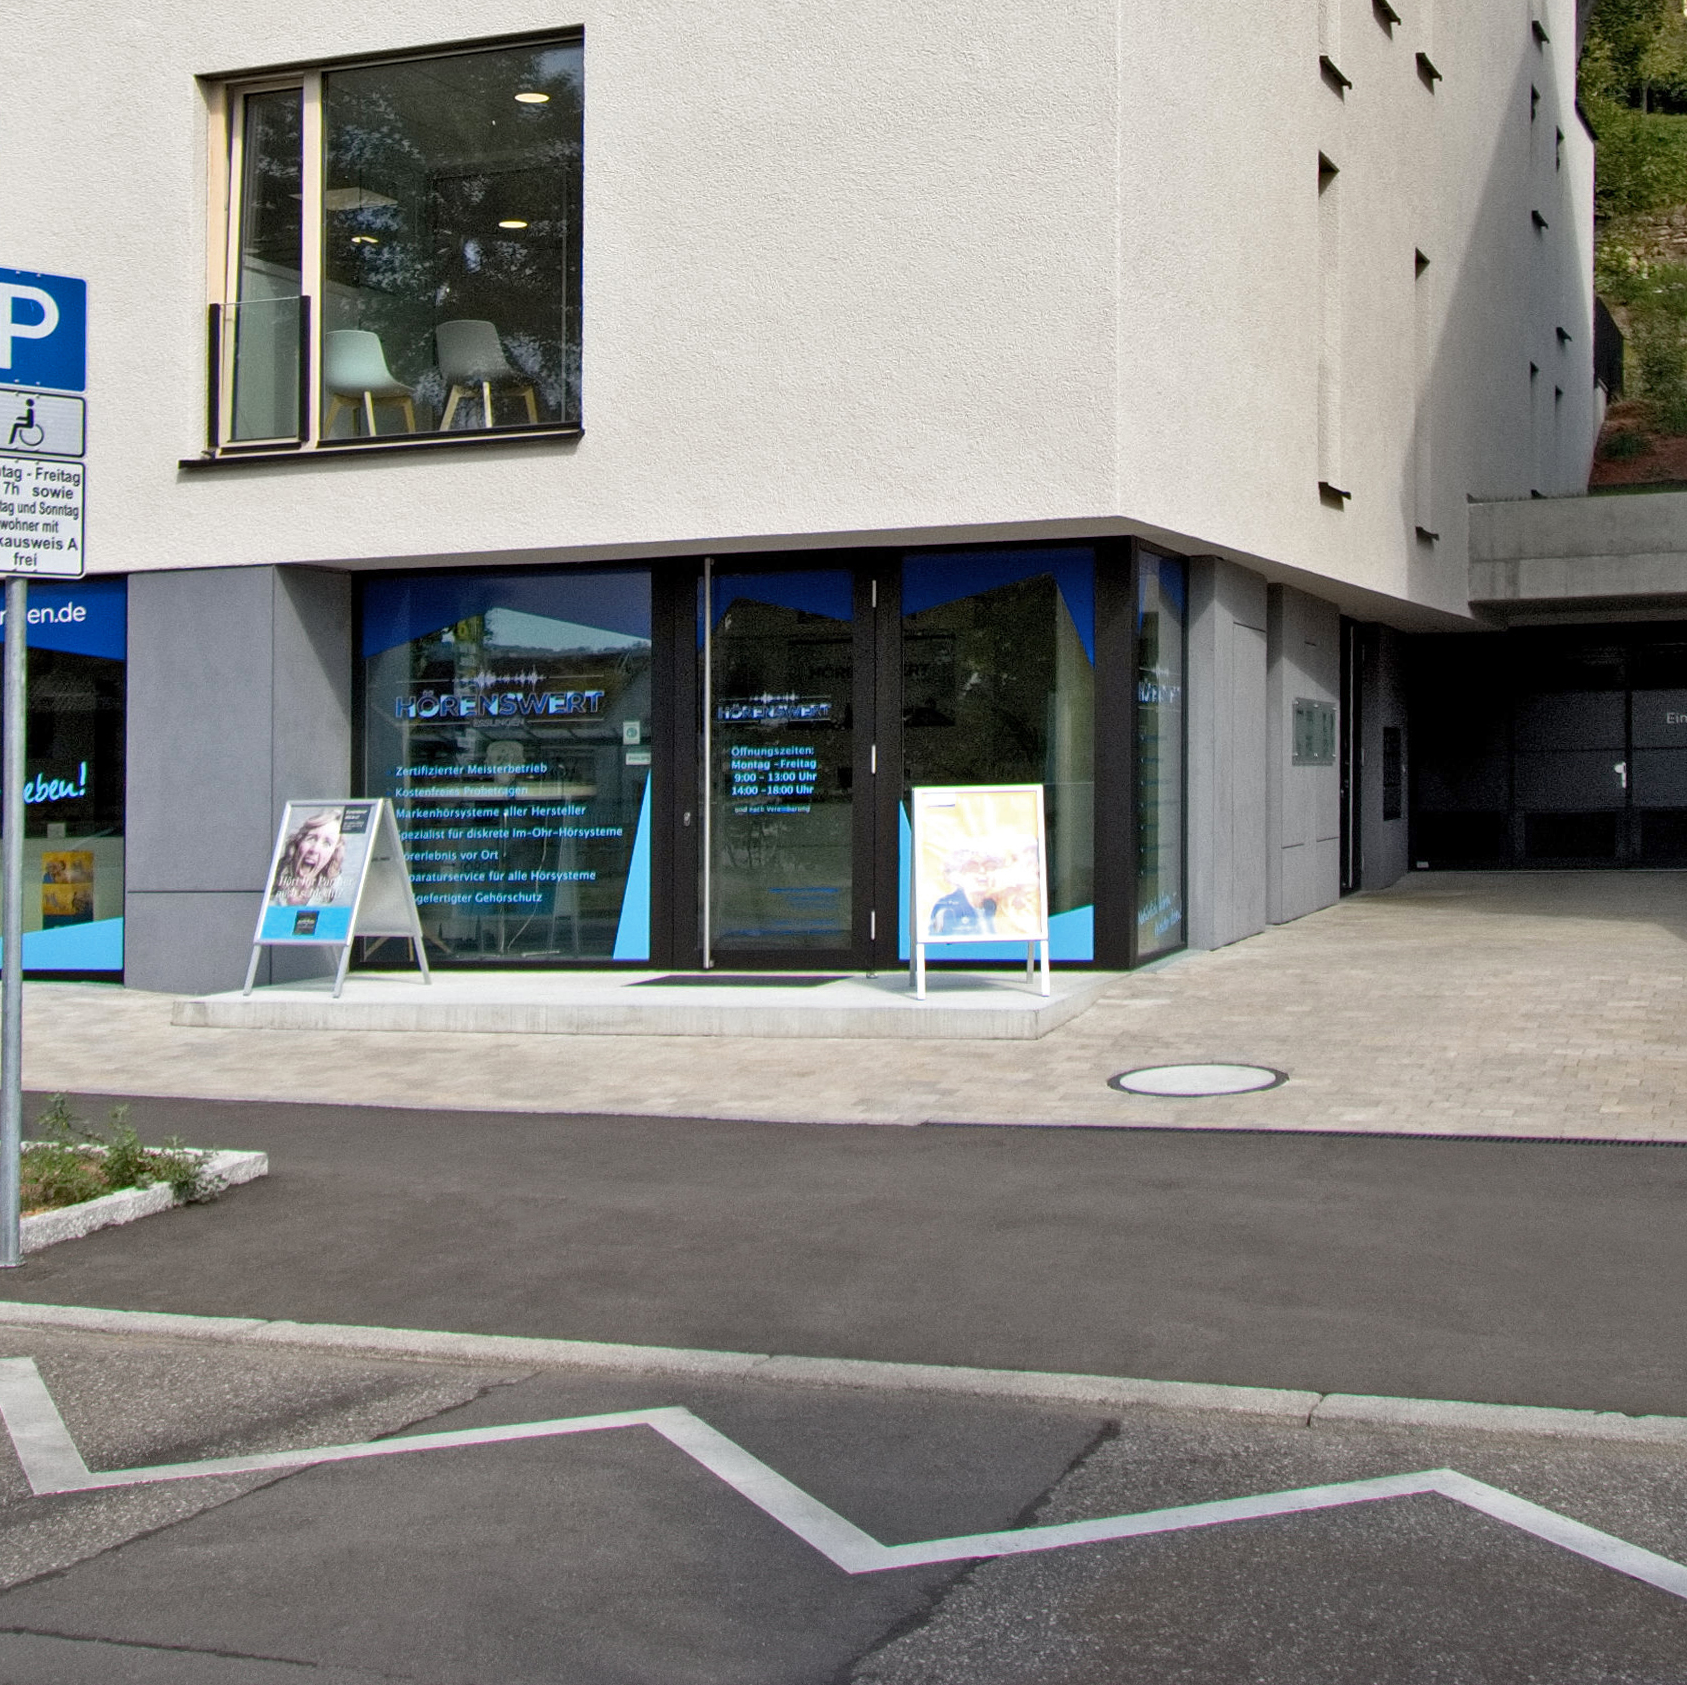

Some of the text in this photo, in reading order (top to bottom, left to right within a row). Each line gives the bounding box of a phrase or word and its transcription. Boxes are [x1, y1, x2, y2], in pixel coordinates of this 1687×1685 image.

[35, 467, 80, 487] Freitag
[3, 482, 20, 495] 7h
[32, 486, 74, 500] sowie
[18, 502, 36, 514] und
[39, 502, 79, 521] Sonntag
[42, 520, 59, 533] mit
[67, 538, 78, 551] A
[14, 552, 37, 567] frei
[395, 690, 605, 718] HÖRENSWERT
[731, 746, 815, 757] Öffnungszeiten:
[395, 763, 548, 777] Zertifizierter Meisterbetrieb
[731, 760, 771, 771] Montag
[22, 761, 87, 805] eben!
[734, 774, 757, 783] 9:00
[768, 773, 796, 782] 13:00
[798, 772, 817, 781] Uhr
[395, 786, 528, 799] Kostenfreies Probetragen
[731, 787, 758, 796] 14:00
[796, 785, 815, 794] Uhr
[396, 806, 587, 820] Markenhörsysteme aller Hersteller
[399, 826, 623, 841] pezialist für diskrete Im-Ohr-Hörsysteme
[460, 851, 477, 860] vor
[481, 850, 499, 859] Ort
[409, 870, 596, 883] paraturservice für alle Hörsysteme
[416, 891, 542, 904] gefertigter Gehörschutz
